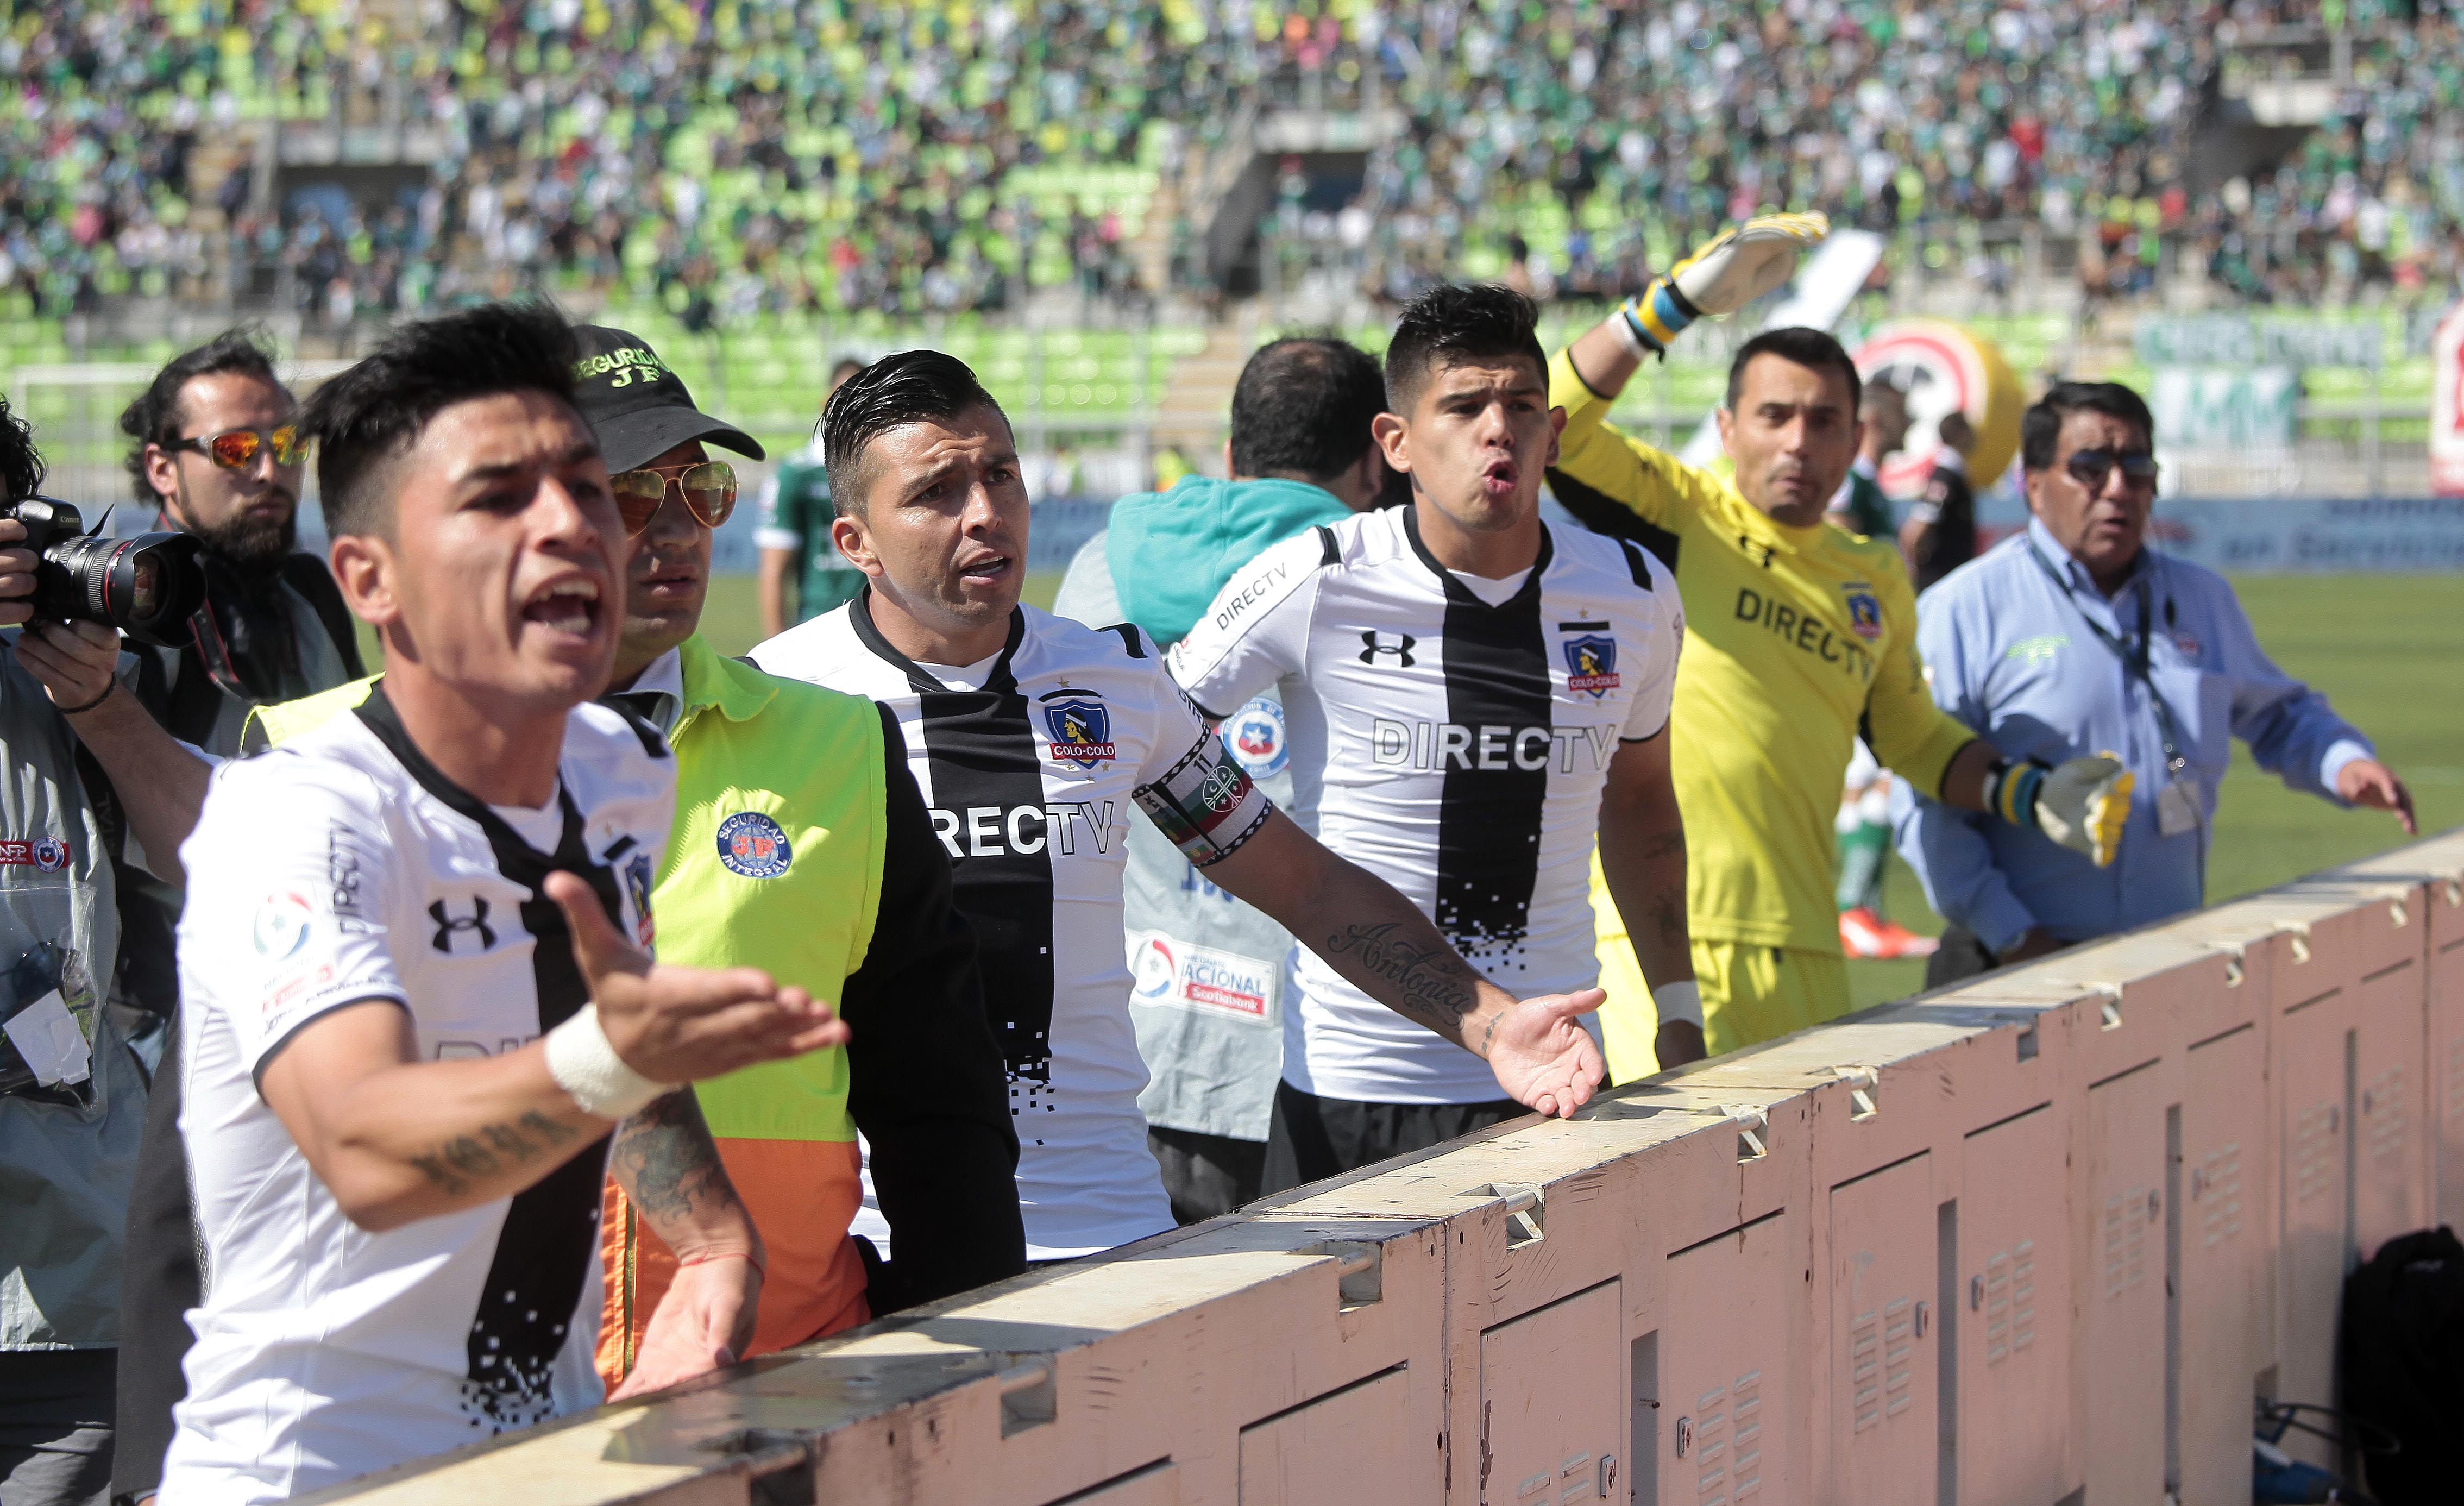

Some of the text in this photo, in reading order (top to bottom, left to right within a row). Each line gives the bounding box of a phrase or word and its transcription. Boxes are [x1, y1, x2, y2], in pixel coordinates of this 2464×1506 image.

[1216, 562, 1287, 631] DIRECTV
[1735, 586, 1876, 683] DIRECTV
[1570, 675, 1619, 690] COLO-COLO
[1054, 744, 1115, 757] COLO-COLO
[1374, 718, 1617, 774] DIRECTV
[719, 814, 786, 845] SEGURIDAD
[928, 800, 1115, 859] RECTV
[0, 844, 27, 857] NFP
[721, 854, 788, 877] INTEGRAL
